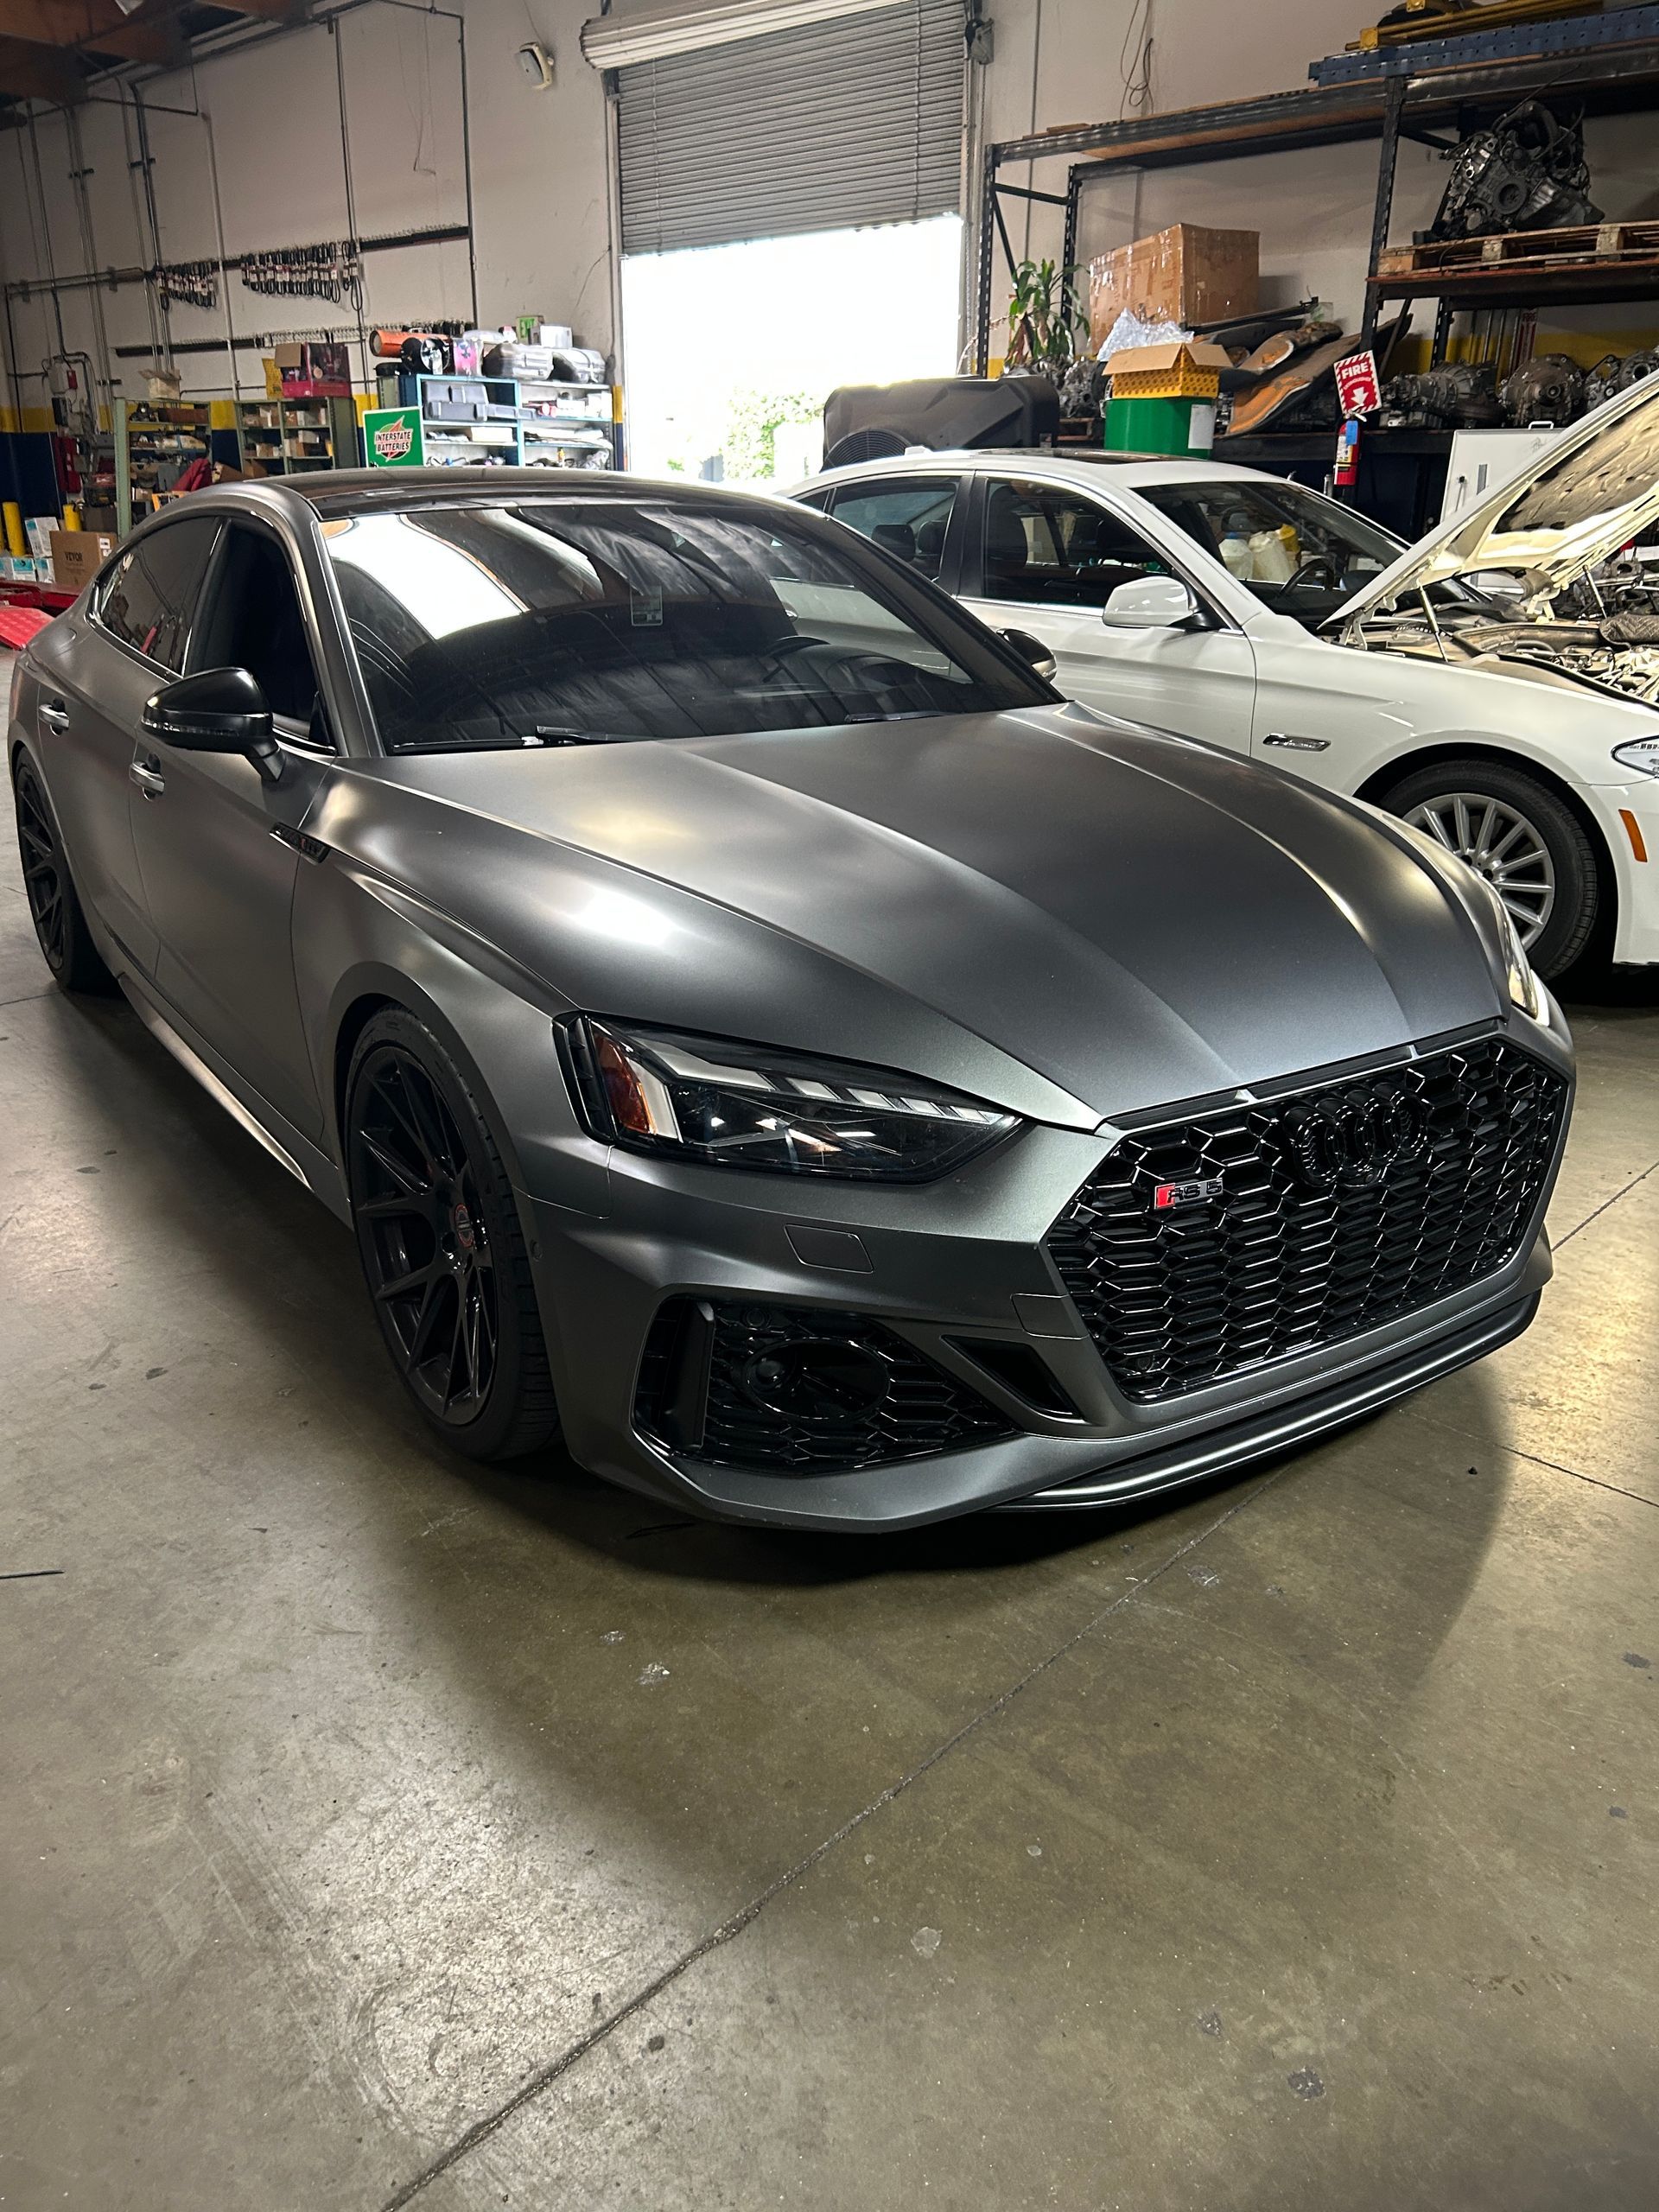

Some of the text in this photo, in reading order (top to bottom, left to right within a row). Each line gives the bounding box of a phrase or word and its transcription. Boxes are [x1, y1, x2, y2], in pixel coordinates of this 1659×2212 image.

[1341, 362, 1369, 379] FIRE
[376, 432, 410, 441] INTERSTATE
[378, 442, 409, 451] BATTERIES
